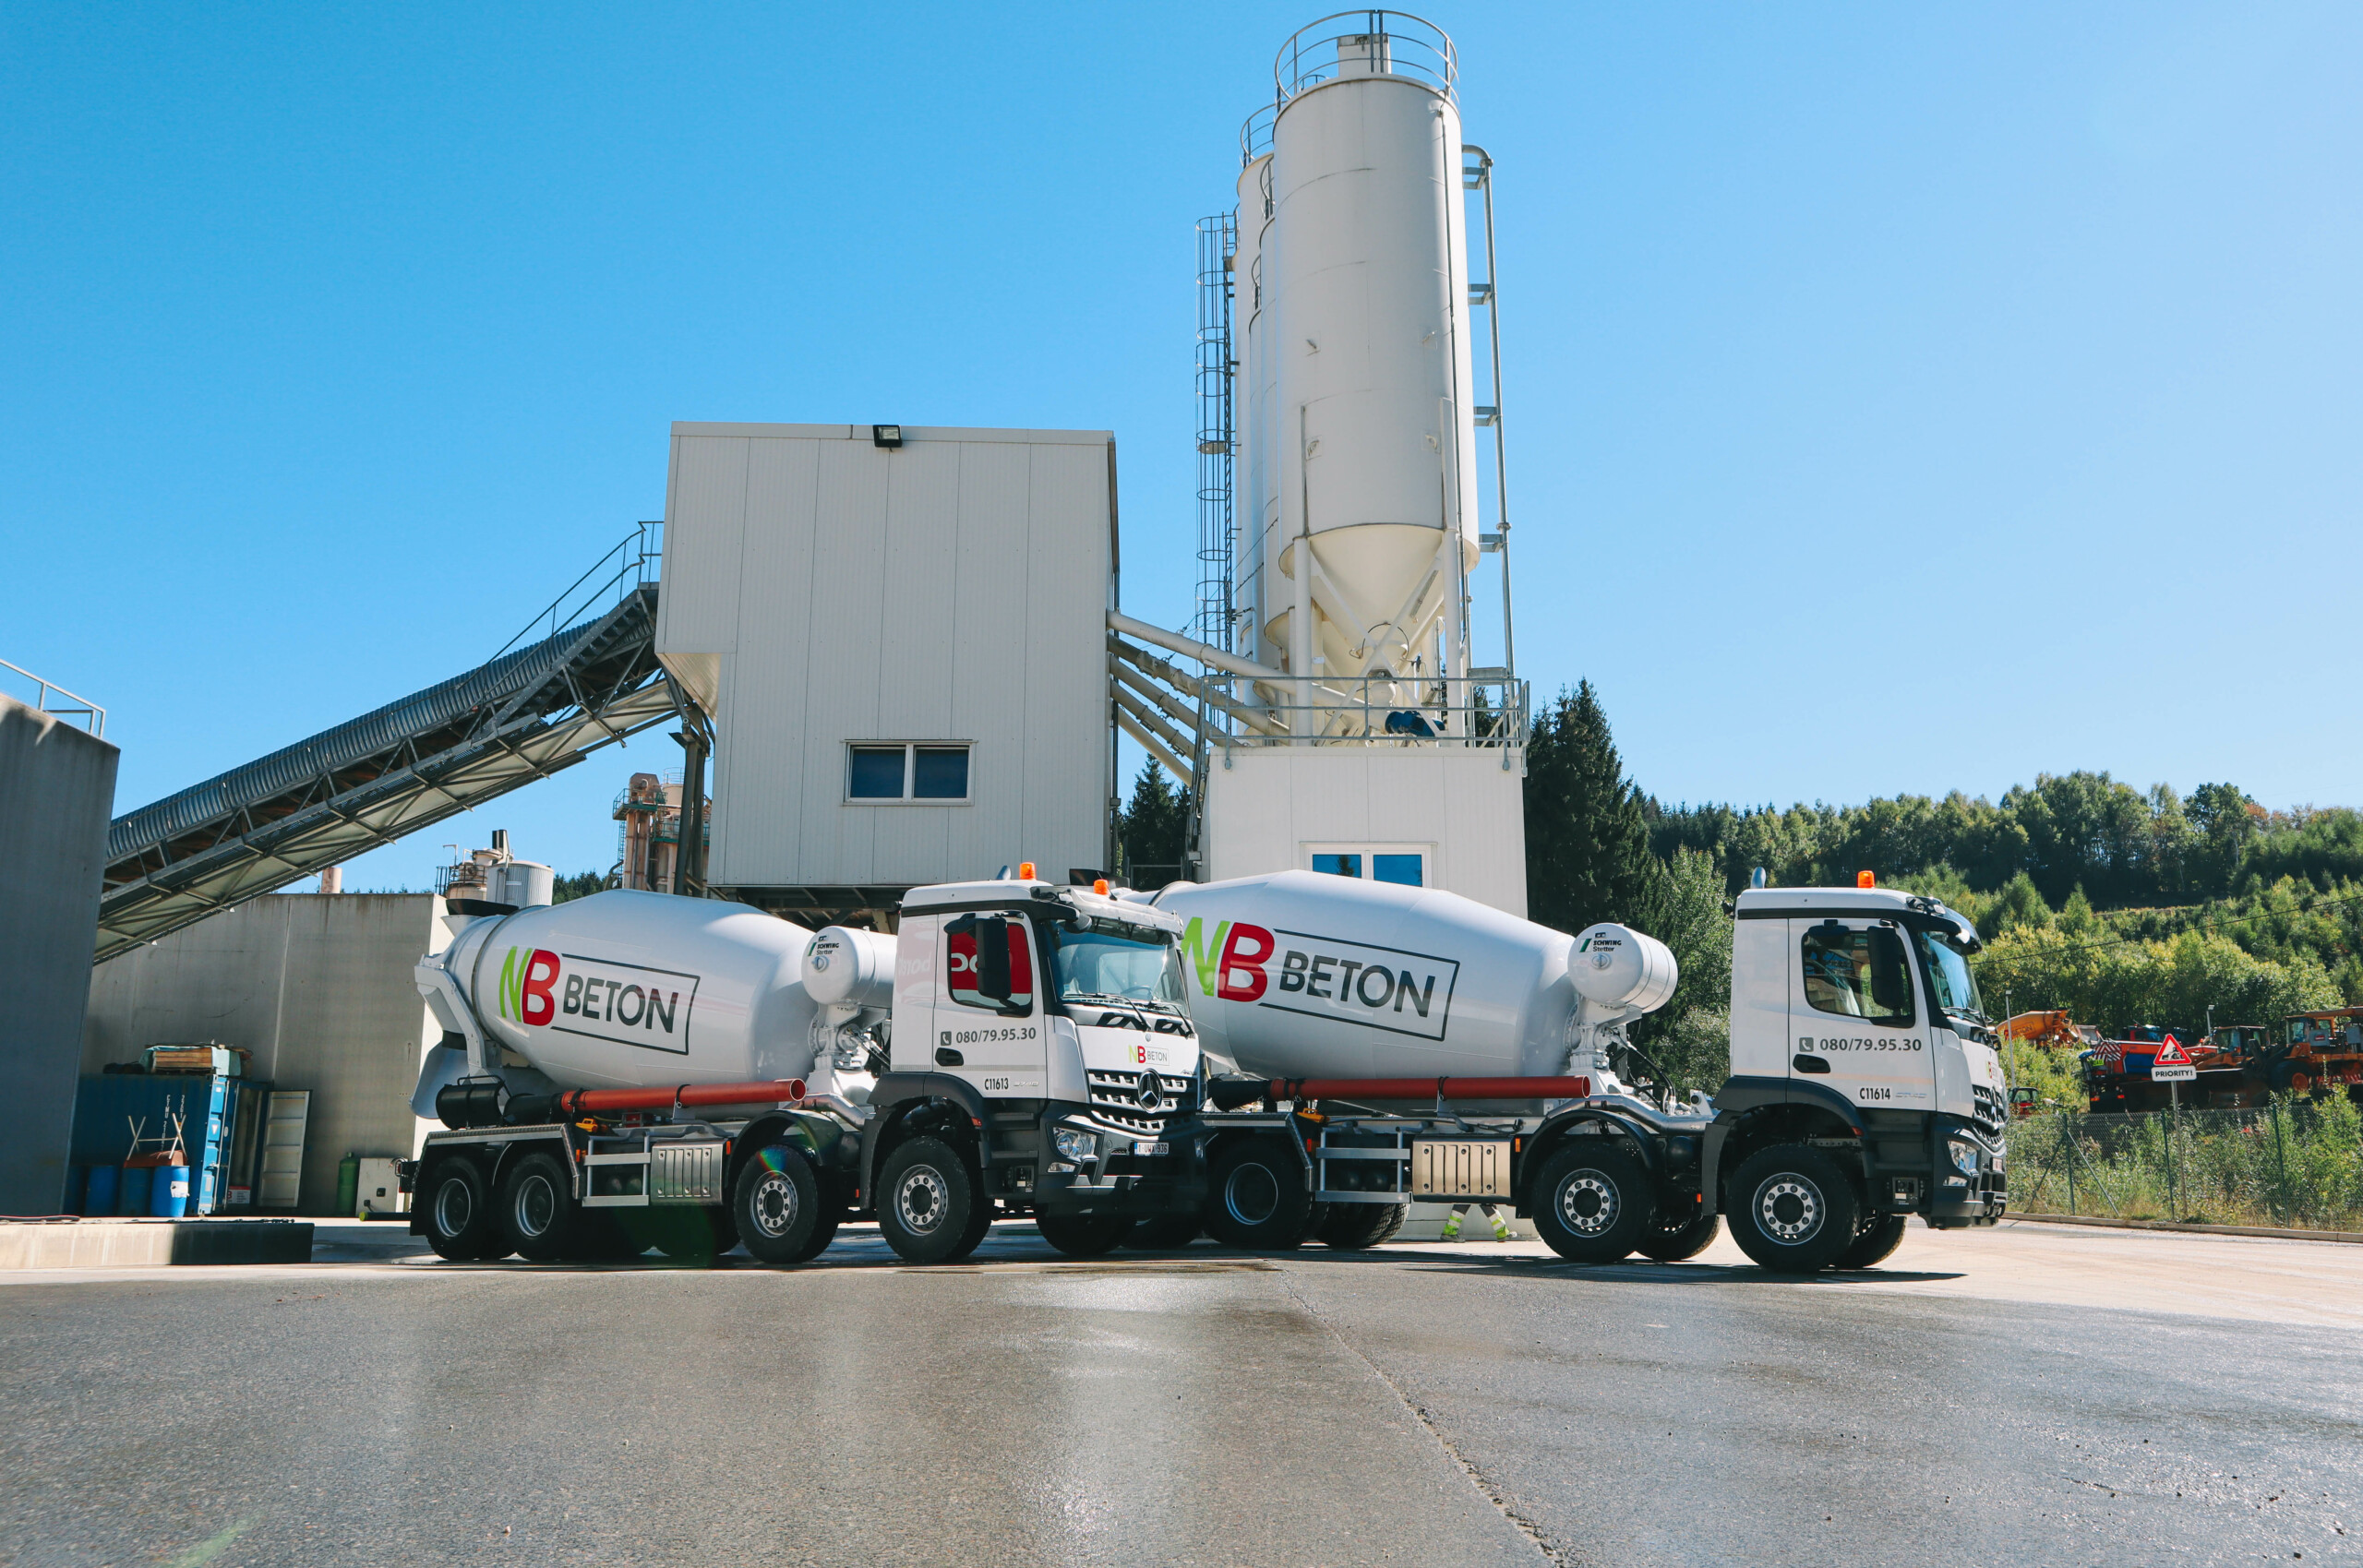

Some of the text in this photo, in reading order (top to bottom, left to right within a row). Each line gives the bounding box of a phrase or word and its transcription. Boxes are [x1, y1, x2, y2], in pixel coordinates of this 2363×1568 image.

[1182, 916, 1436, 1018] NB BETON
[498, 945, 679, 1034] NB BETON
[955, 1027, 1037, 1043] 080/79.95.30
[1819, 1037, 1922, 1051] 080/79.95.30
[1128, 1044, 1168, 1063] NB BETON
[984, 1077, 1009, 1090] C11613
[1859, 1087, 1890, 1099] C11614
